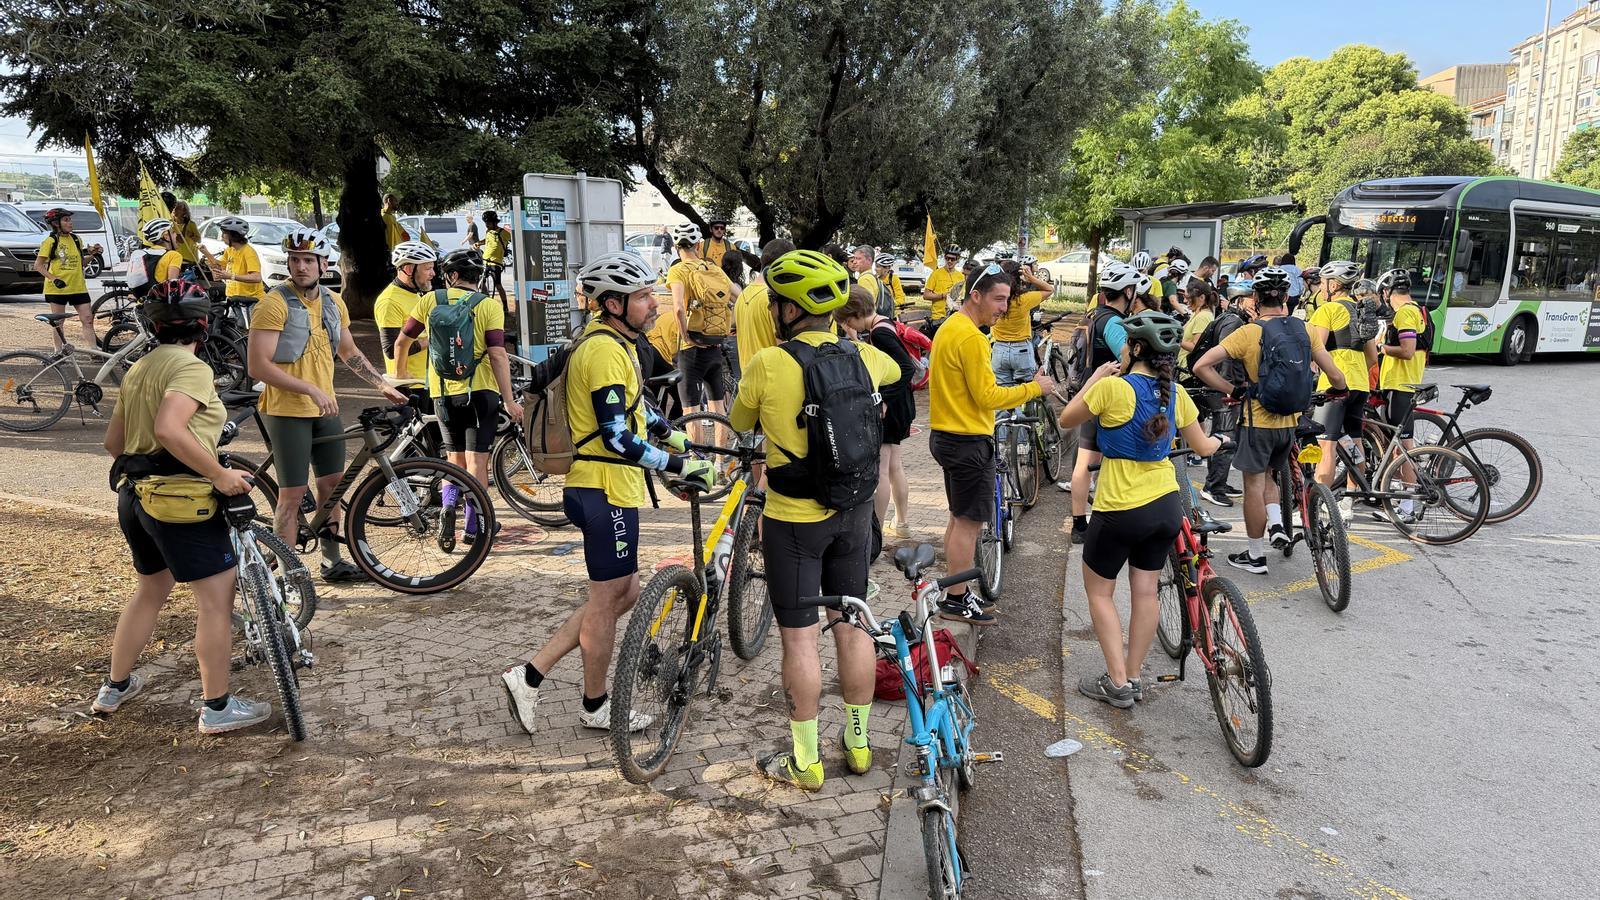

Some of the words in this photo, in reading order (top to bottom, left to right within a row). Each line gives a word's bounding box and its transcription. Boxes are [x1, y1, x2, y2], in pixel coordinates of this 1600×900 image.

[1546, 222, 1556, 230] 960
[1546, 312, 1578, 322] TransGran
[852, 708, 862, 736] SIRO
